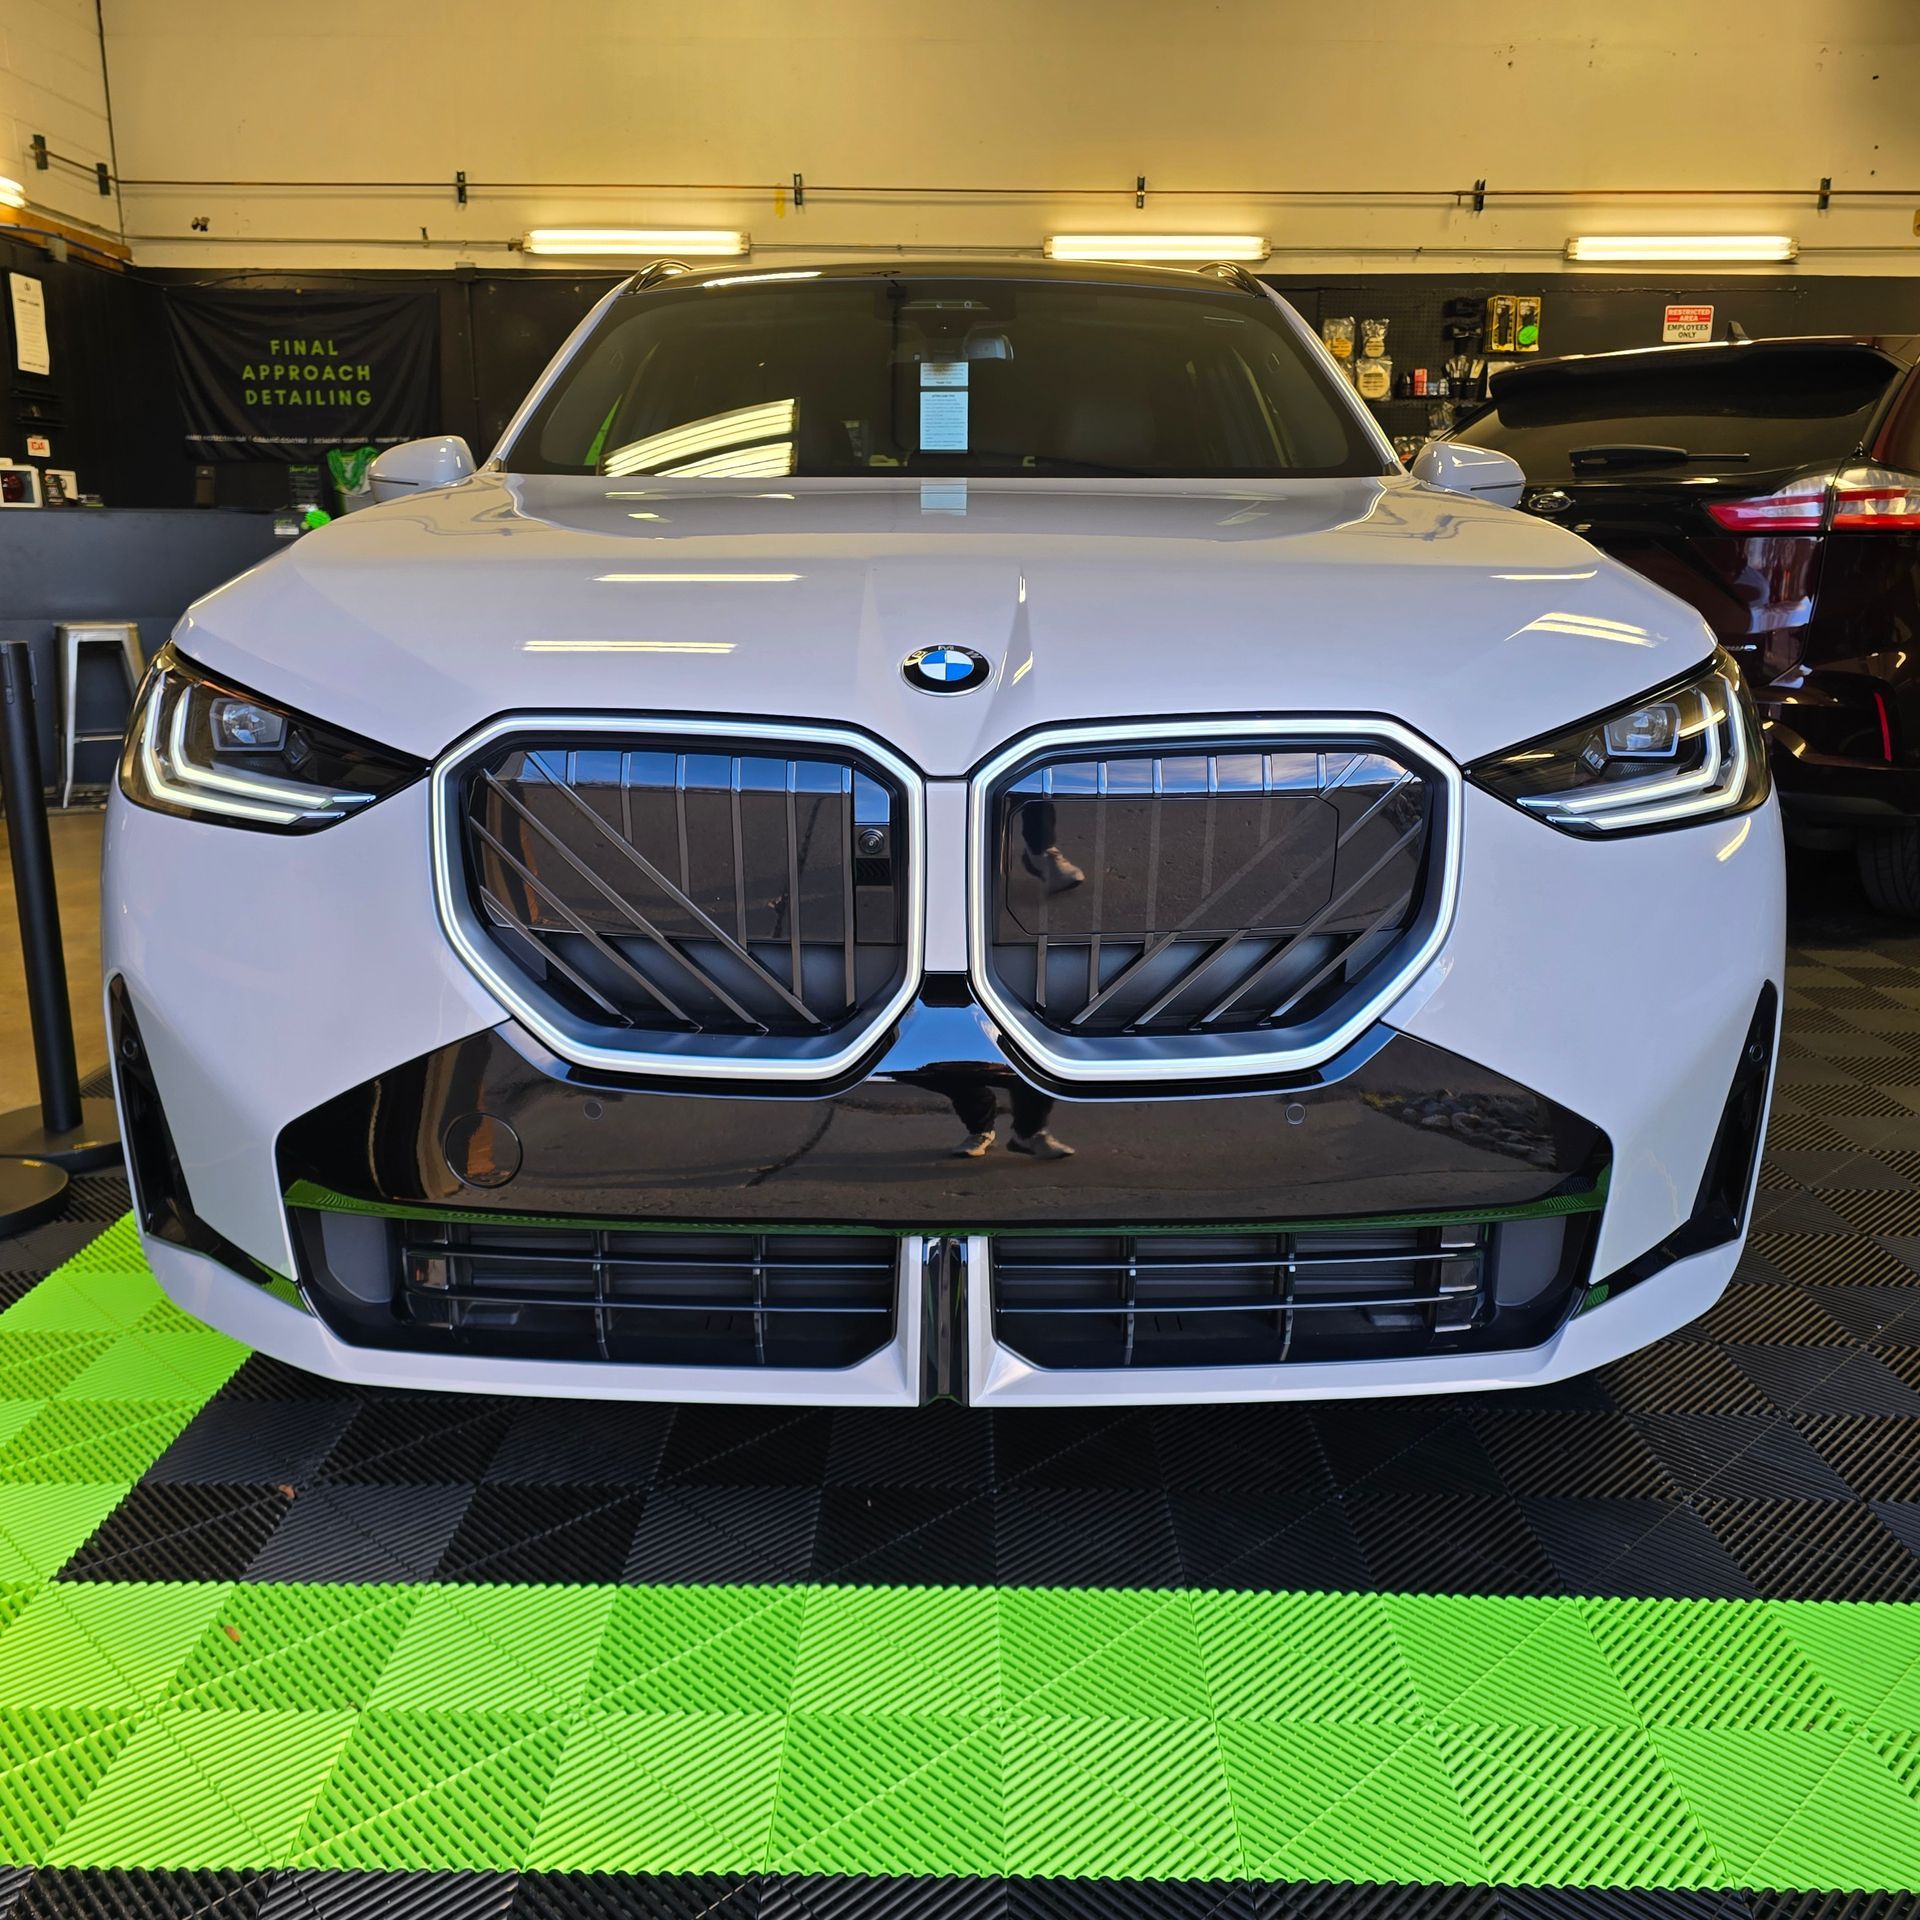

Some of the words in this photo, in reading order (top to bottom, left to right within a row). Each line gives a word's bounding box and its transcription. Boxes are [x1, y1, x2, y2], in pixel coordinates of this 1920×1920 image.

[270, 339, 339, 356] FINAL
[242, 364, 371, 381] APPROACH
[245, 389, 372, 406] DETAILING
